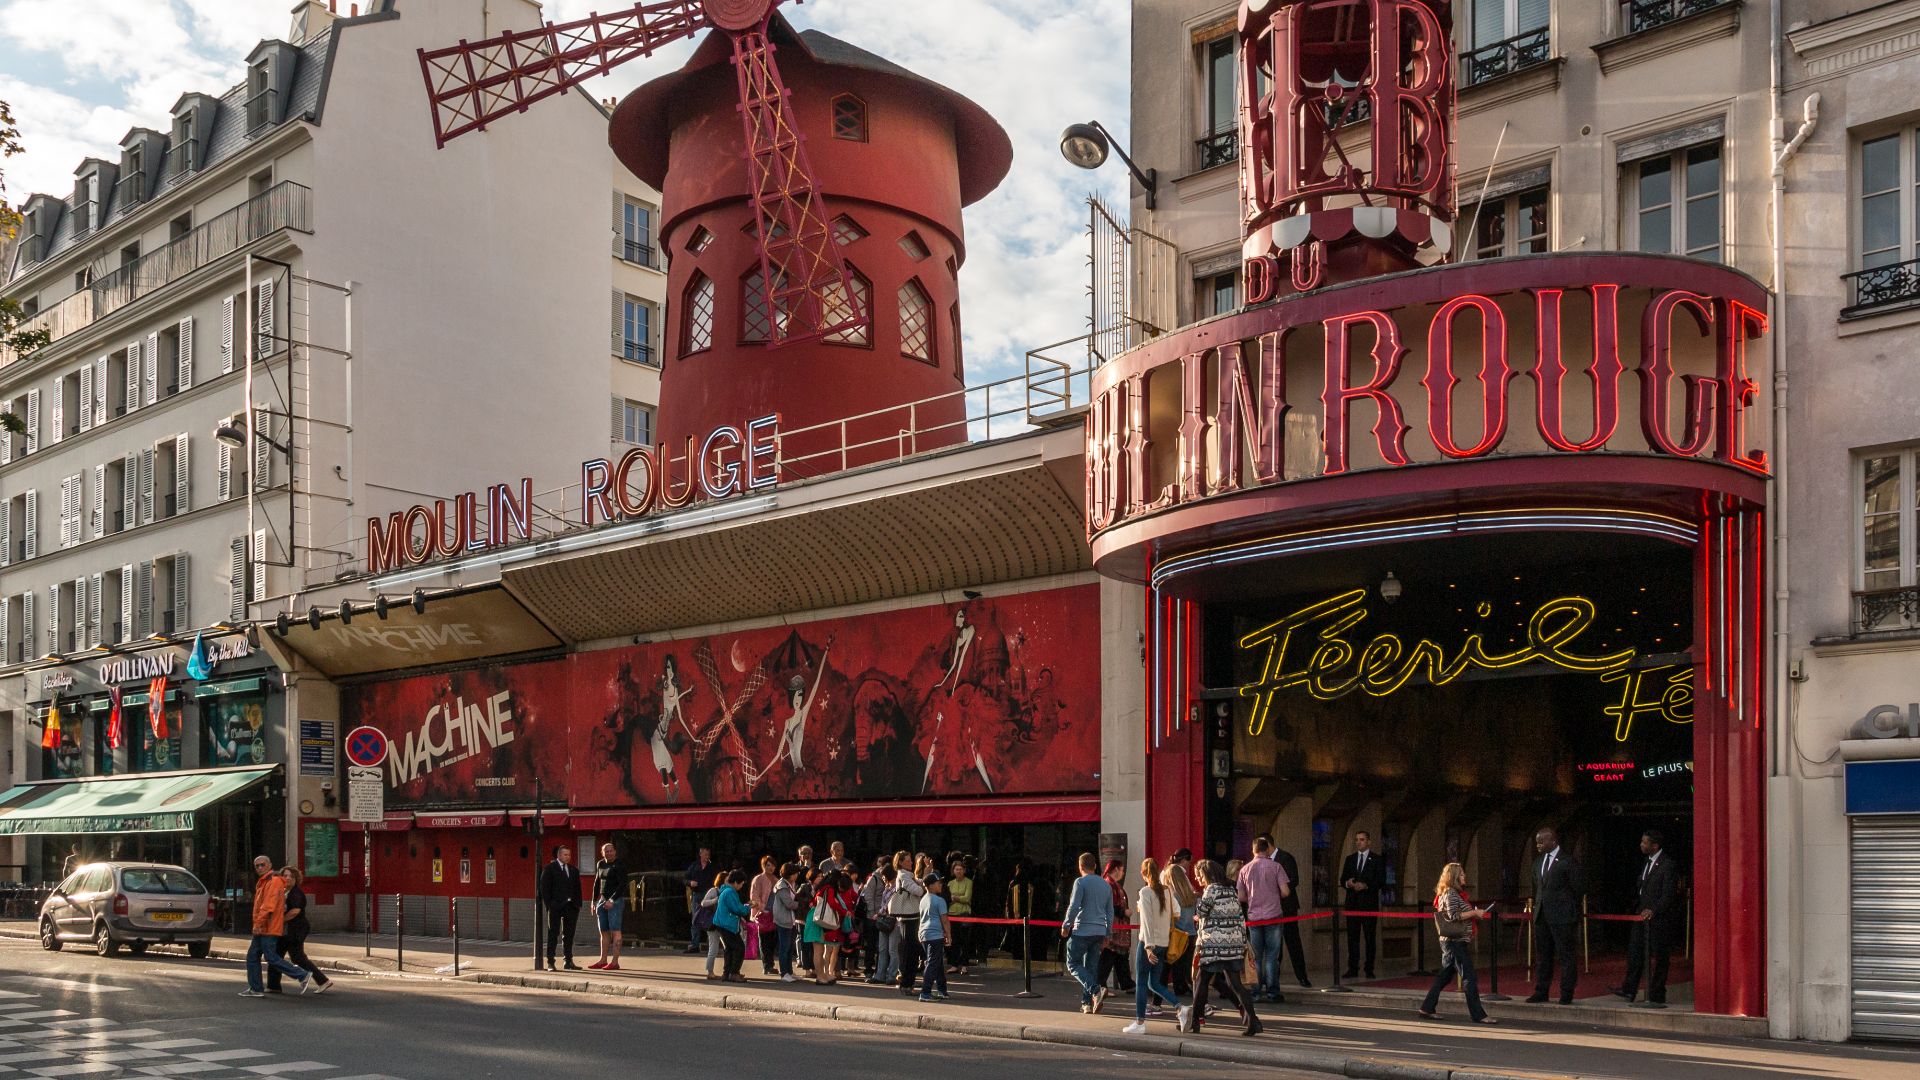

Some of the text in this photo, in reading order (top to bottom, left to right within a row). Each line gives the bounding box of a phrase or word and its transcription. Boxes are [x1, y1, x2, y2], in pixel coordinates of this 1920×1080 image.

[1242, 241, 1329, 304] DU
[1320, 283, 1770, 480] ROUGE
[367, 412, 783, 573] MOULIN ROUGE
[100, 653, 176, 685] O'SULLIVANS
[207, 639, 249, 667] By the Mill
[1600, 664, 1694, 742] Fé
[388, 690, 515, 788] MACHINE
[474, 777, 516, 787] CONCERTS CLUB
[1643, 768, 1655, 778] LE
[1657, 762, 1683, 776] PLUS
[431, 818, 461, 826] CONCERTS
[470, 817, 487, 825] CLUB
